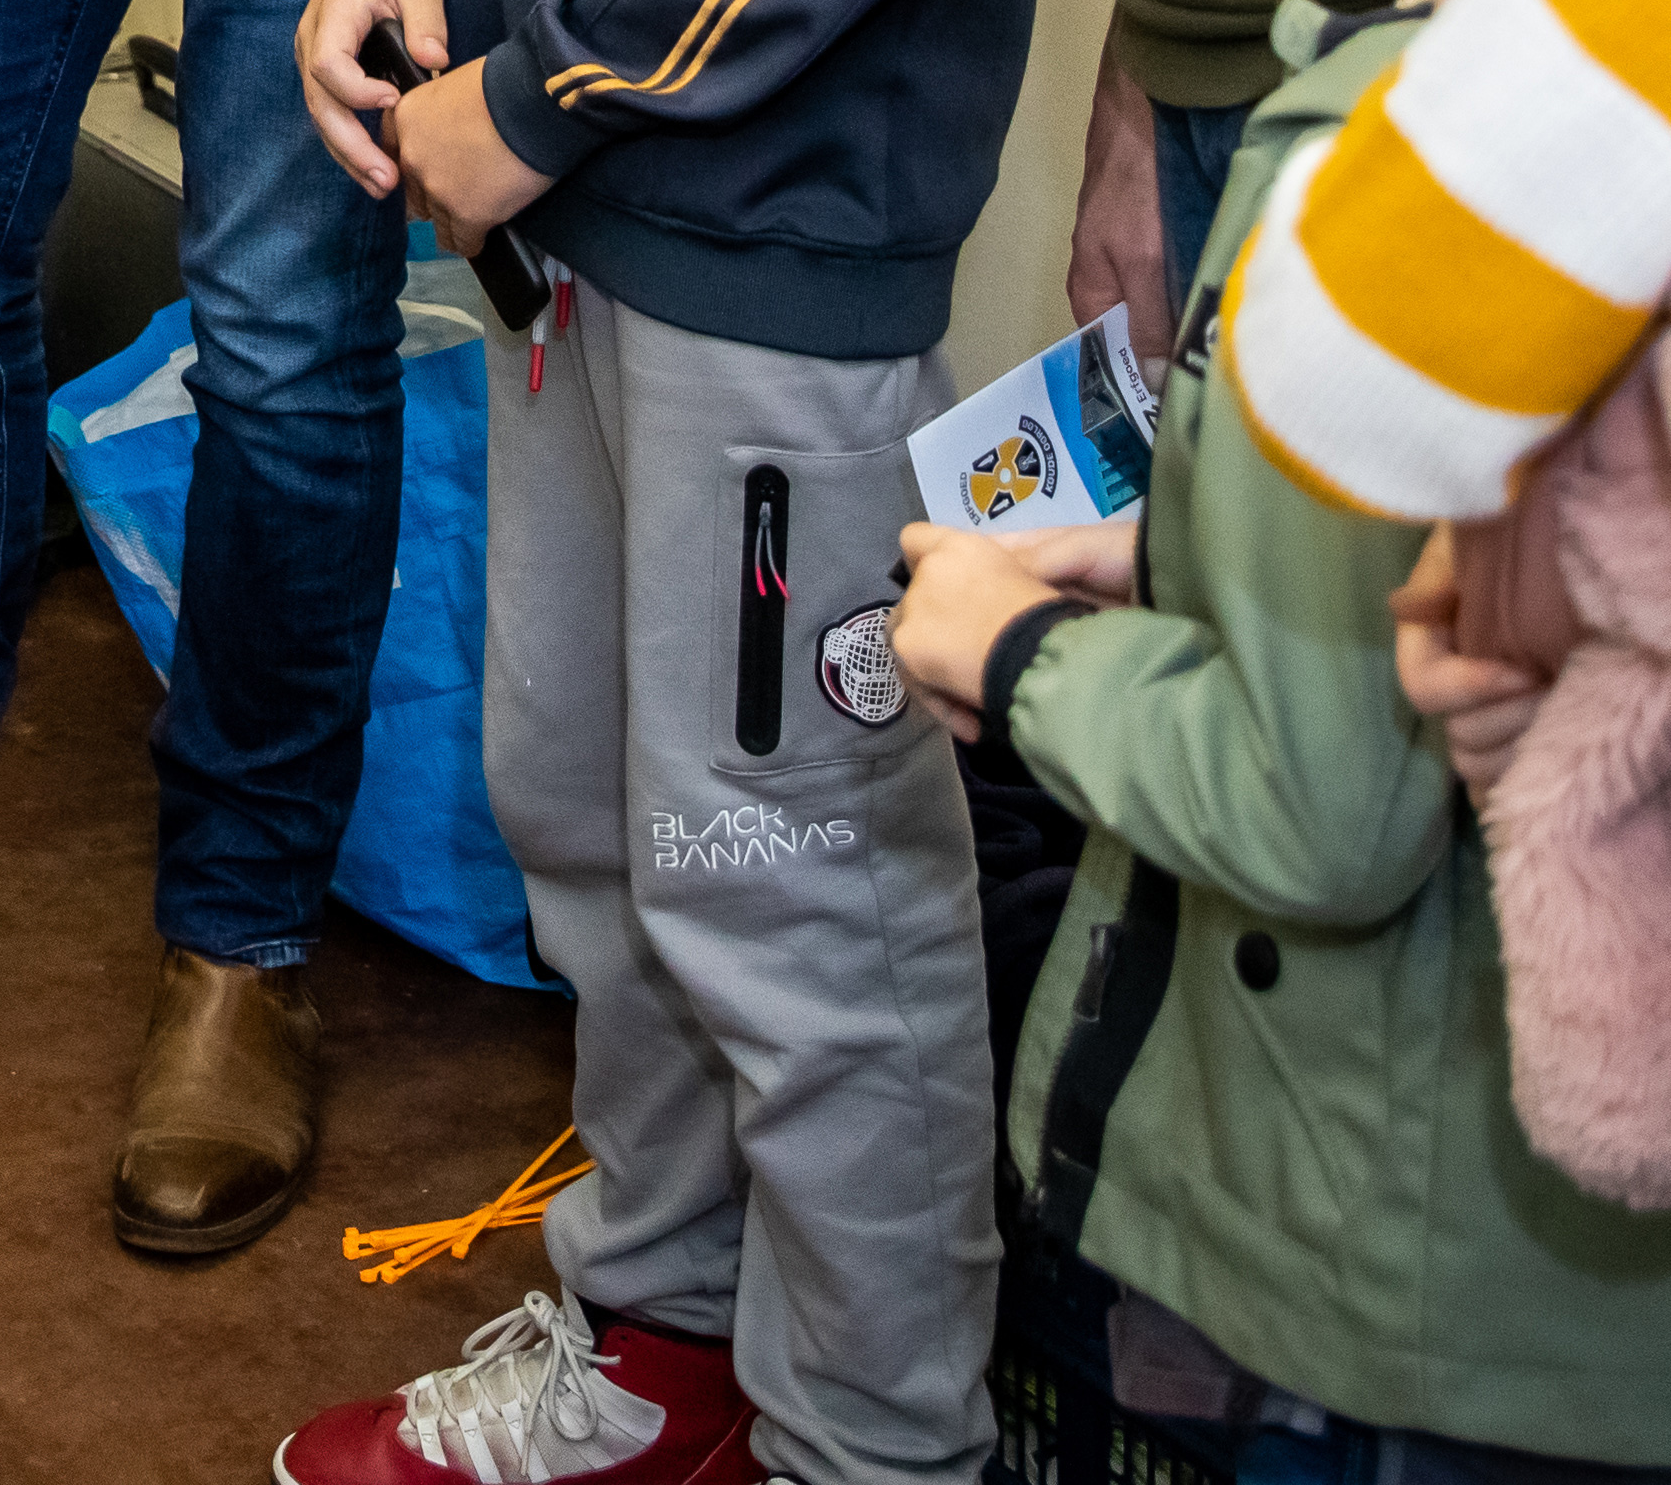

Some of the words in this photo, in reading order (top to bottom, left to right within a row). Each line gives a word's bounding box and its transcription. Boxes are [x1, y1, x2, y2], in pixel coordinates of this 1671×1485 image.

[1118, 346, 1147, 404] Erfgoed
[1044, 451, 1057, 494] KOUDE
[959, 471, 982, 527] ERFGOED
[651, 802, 785, 840] BLACK
[654, 819, 856, 871] BANANAS
